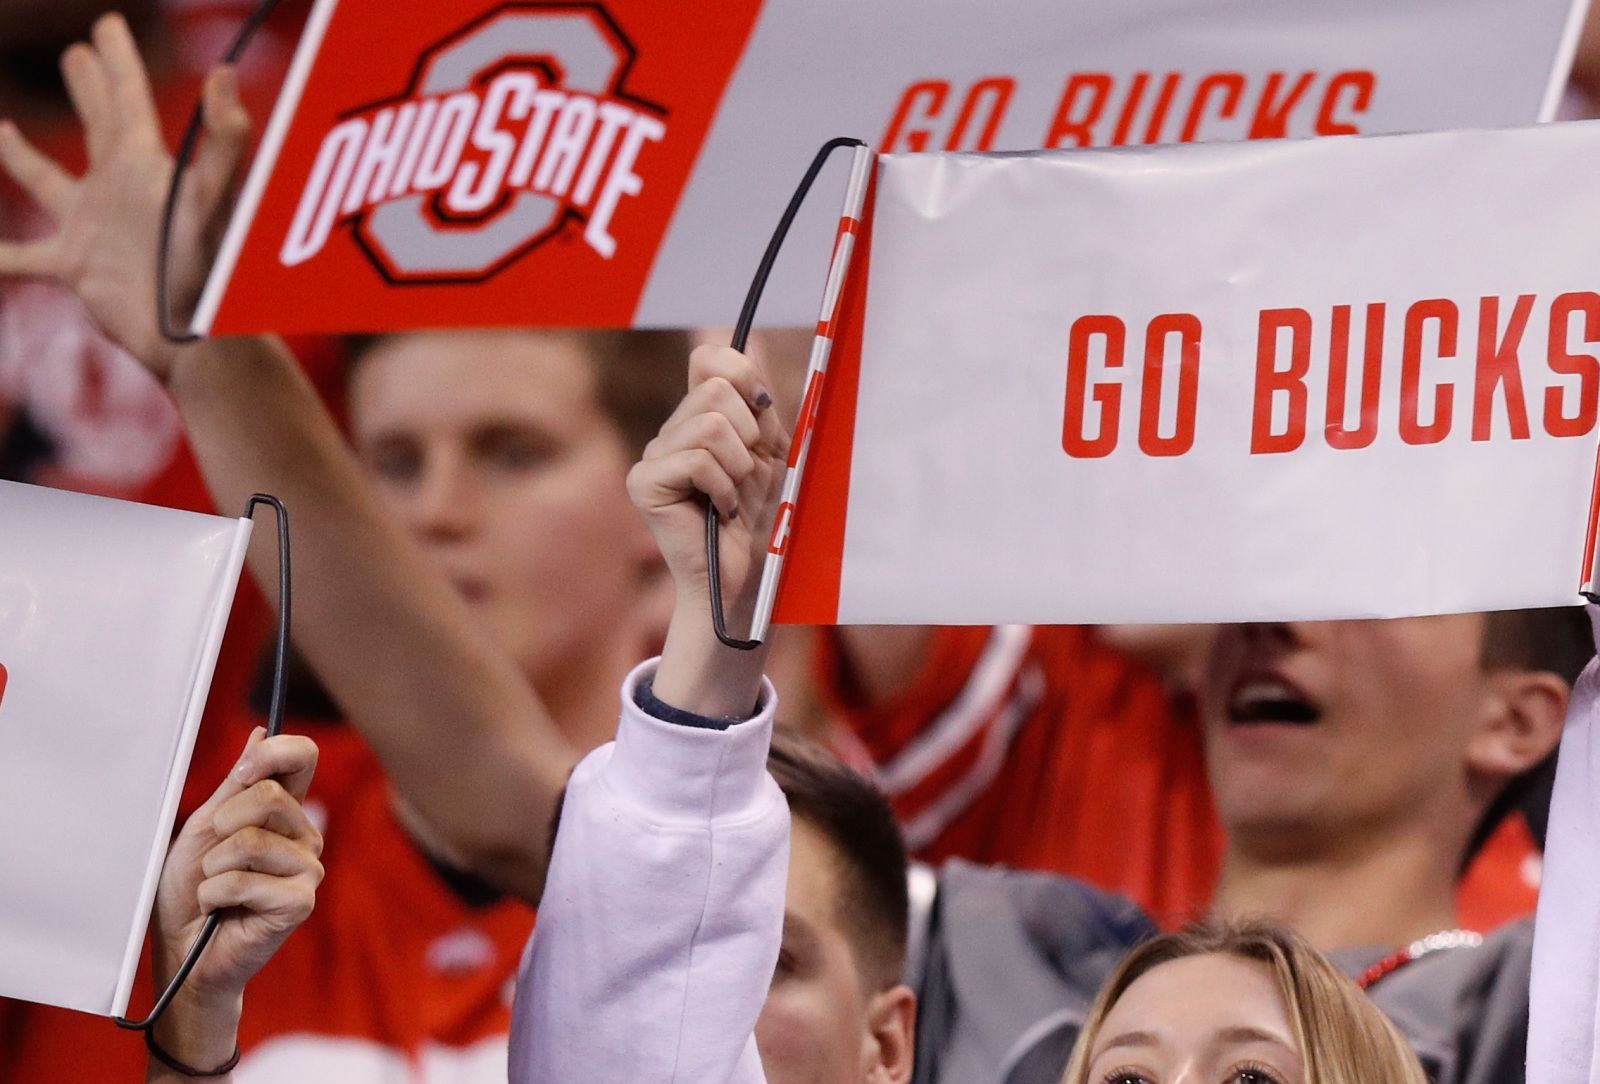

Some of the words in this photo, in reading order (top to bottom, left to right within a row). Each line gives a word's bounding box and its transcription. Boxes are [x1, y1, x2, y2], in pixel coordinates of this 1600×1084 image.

[876, 76, 1016, 154] GO
[1044, 70, 1376, 149] BUCKS
[1062, 313, 1202, 459] GO
